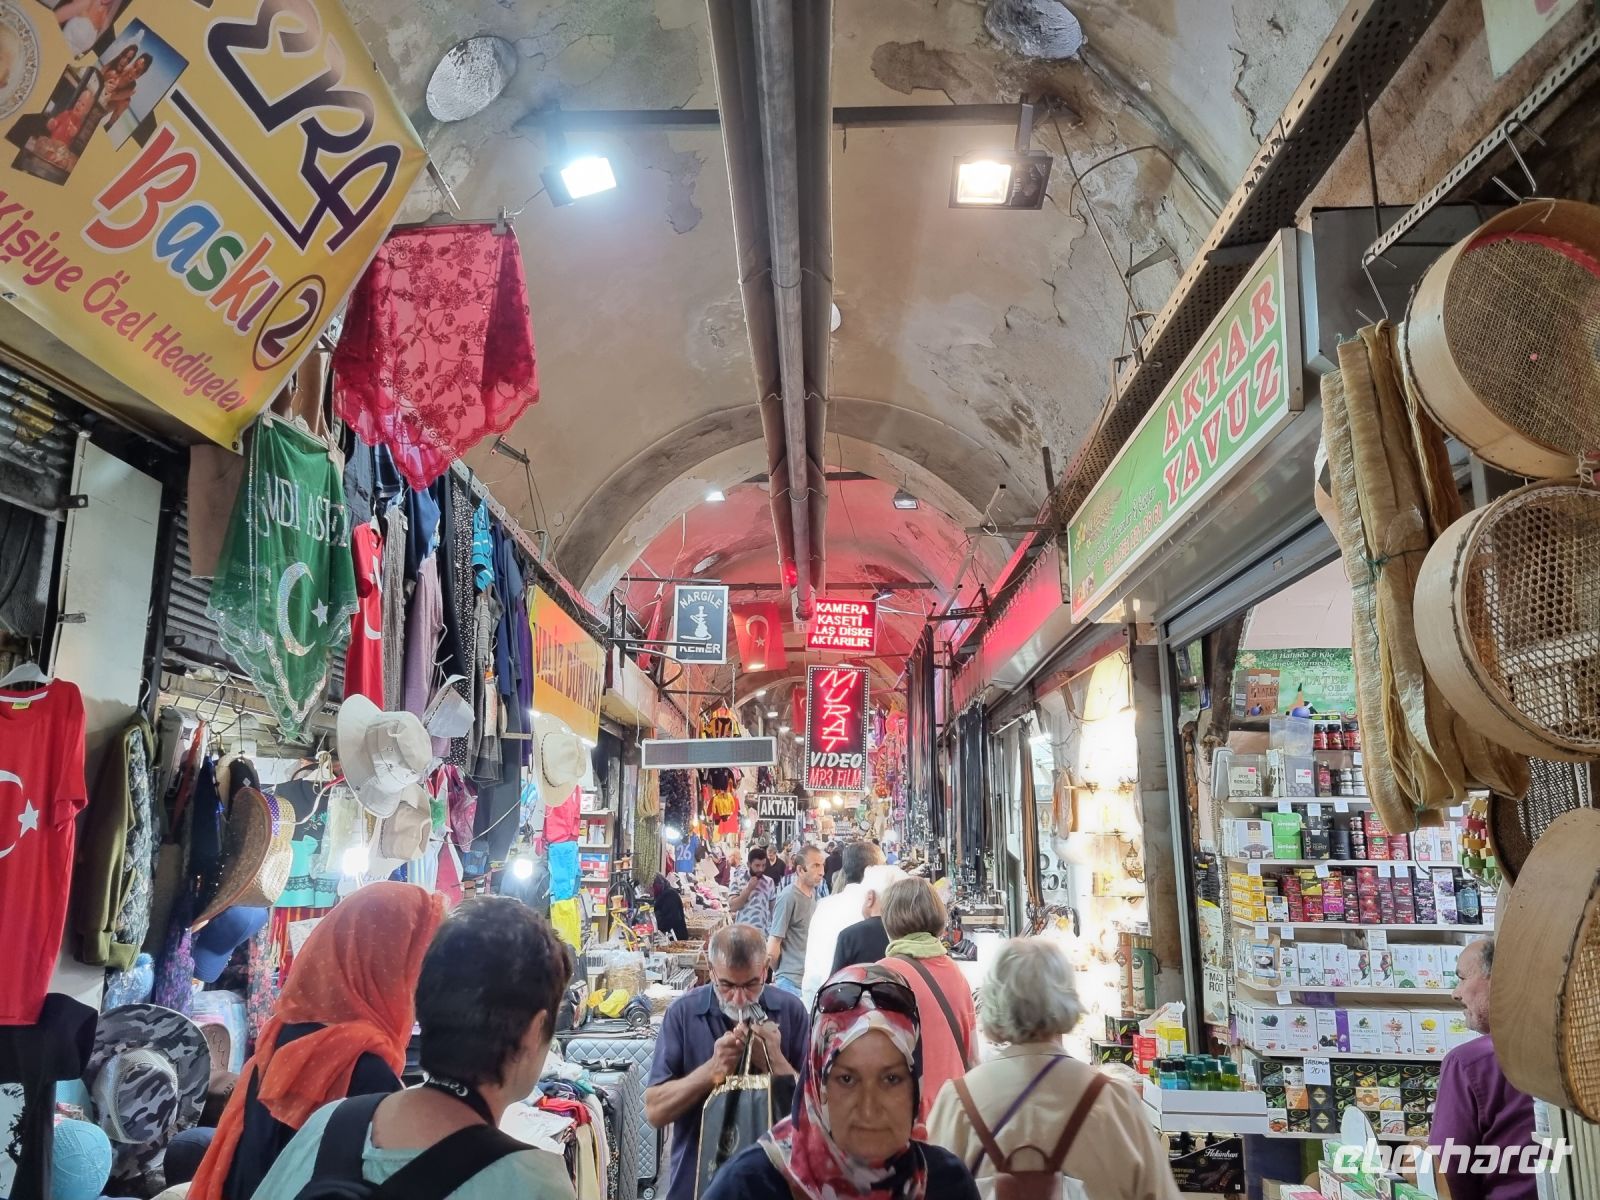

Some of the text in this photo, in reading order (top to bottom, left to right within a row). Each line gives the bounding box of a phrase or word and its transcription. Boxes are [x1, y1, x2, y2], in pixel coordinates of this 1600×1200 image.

[83, 125, 321, 361] Baskı 2
[82, 270, 155, 342] Özel
[142, 323, 249, 413] Hediyeler
[1163, 277, 1277, 456] AKTAR
[1163, 343, 1280, 510] YAVUZ
[680, 591, 723, 609] NARGİLE
[816, 602, 869, 615] KAMERA
[817, 614, 863, 627] KASETİ
[839, 625, 873, 637] DİSKE
[811, 635, 870, 647] AKTARILIR
[820, 670, 858, 752] MURAT
[808, 768, 834, 787] MP3
[760, 800, 795, 816] AKTAR
[676, 844, 692, 861] 26
